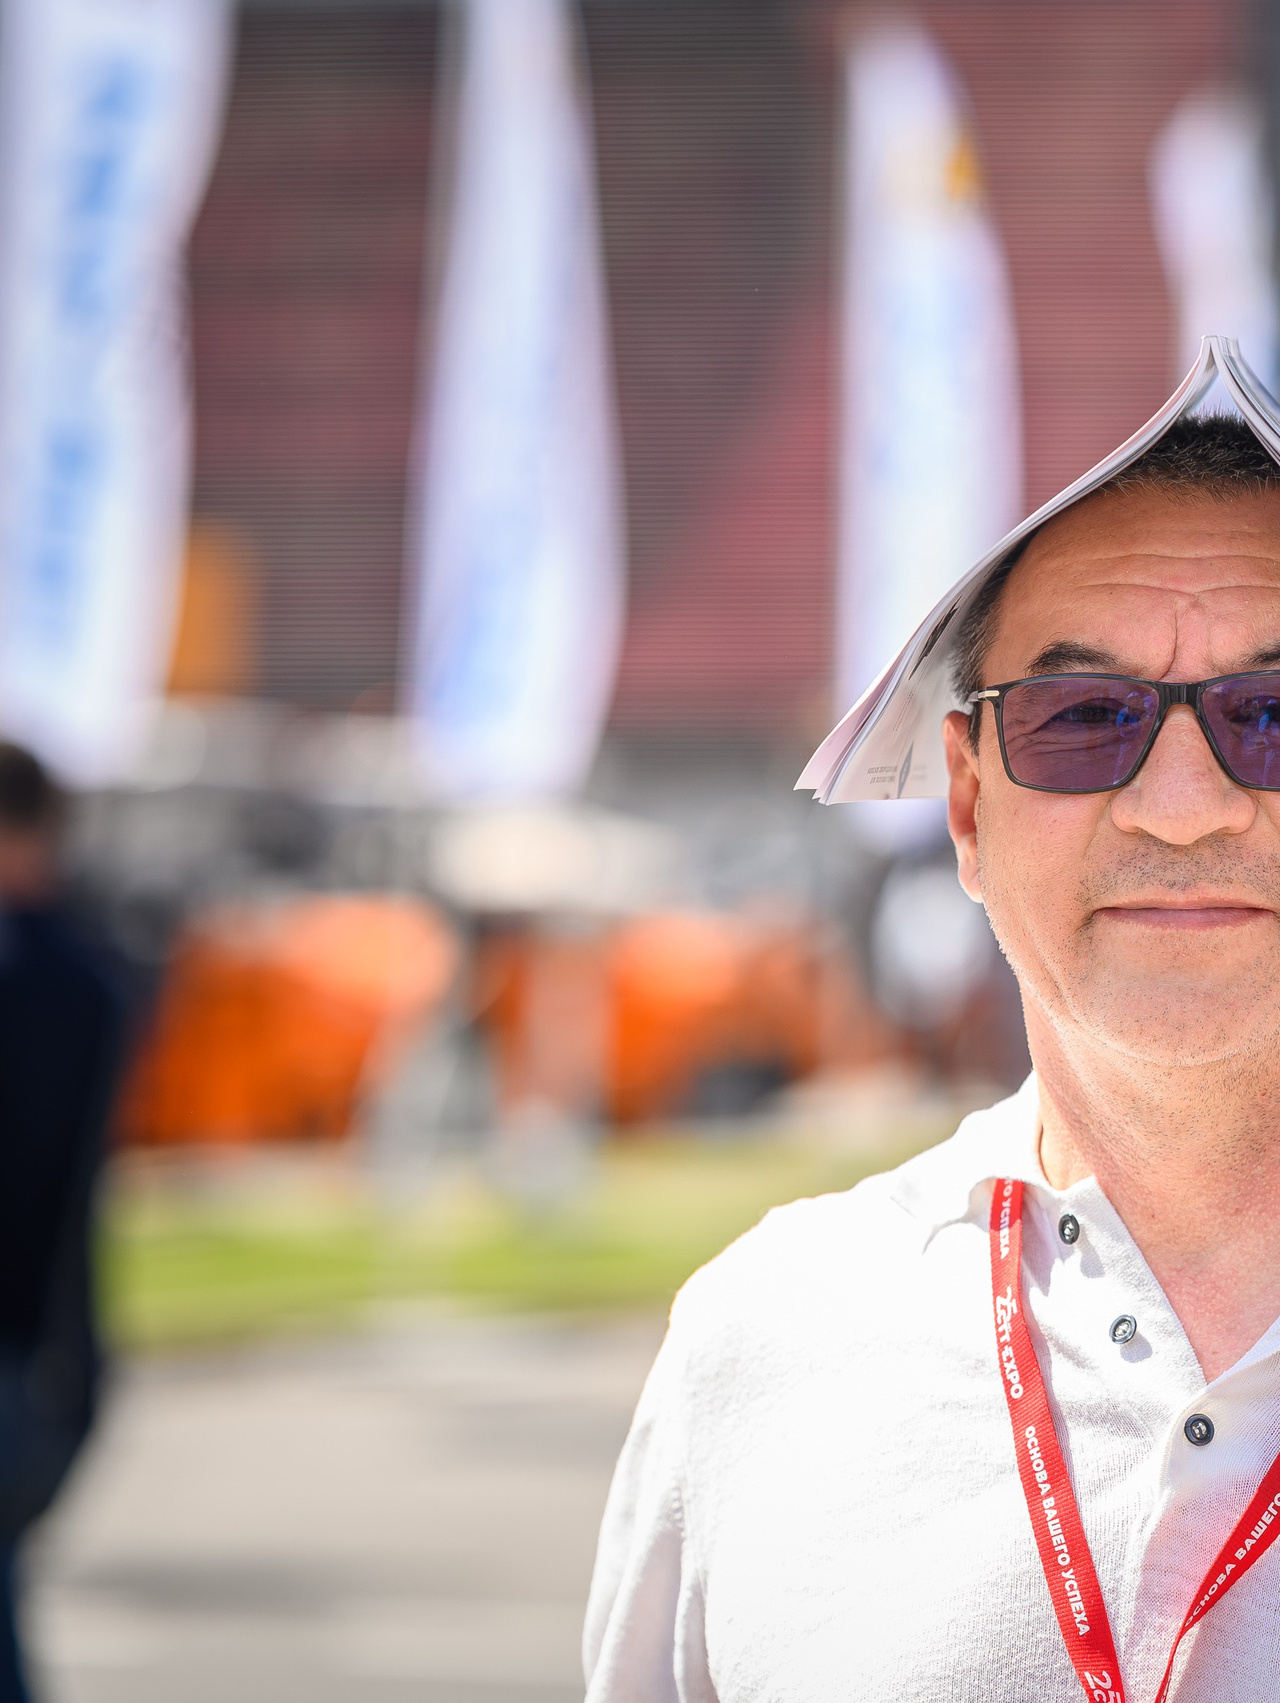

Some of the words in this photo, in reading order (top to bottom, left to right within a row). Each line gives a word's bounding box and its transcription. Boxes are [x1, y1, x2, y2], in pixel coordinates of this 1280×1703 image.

[1002, 1344, 1024, 1399] EXPO
[1025, 1425, 1051, 1496] ОСНОВА
[1042, 1496, 1071, 1567] ВАШЕГО
[1061, 1568, 1091, 1636] УСПЕХА
[1185, 1563, 1236, 1628] ОСНОВА
